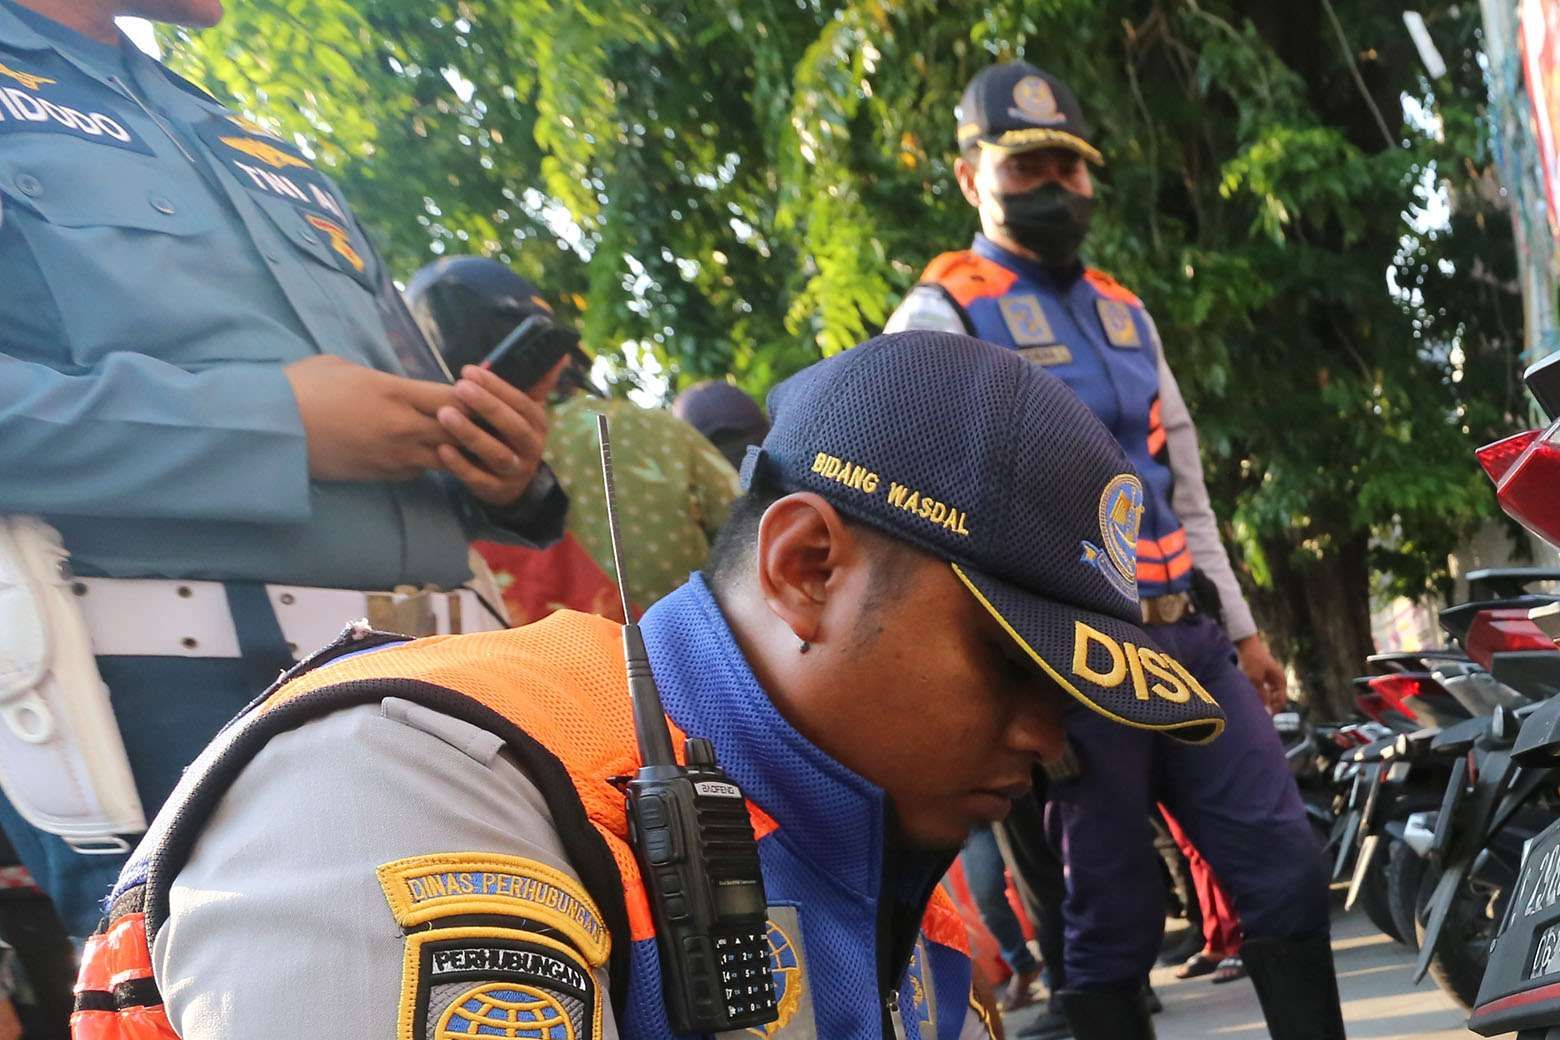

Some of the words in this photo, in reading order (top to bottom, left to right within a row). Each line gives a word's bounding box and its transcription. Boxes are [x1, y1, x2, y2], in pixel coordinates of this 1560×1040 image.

[811, 452, 880, 494] BIDANG
[887, 481, 969, 536] WASDAL
[407, 872, 474, 902] DINAS
[482, 872, 606, 944] PERHUBUNGAN
[432, 948, 585, 991] PERHUBUNGAN
